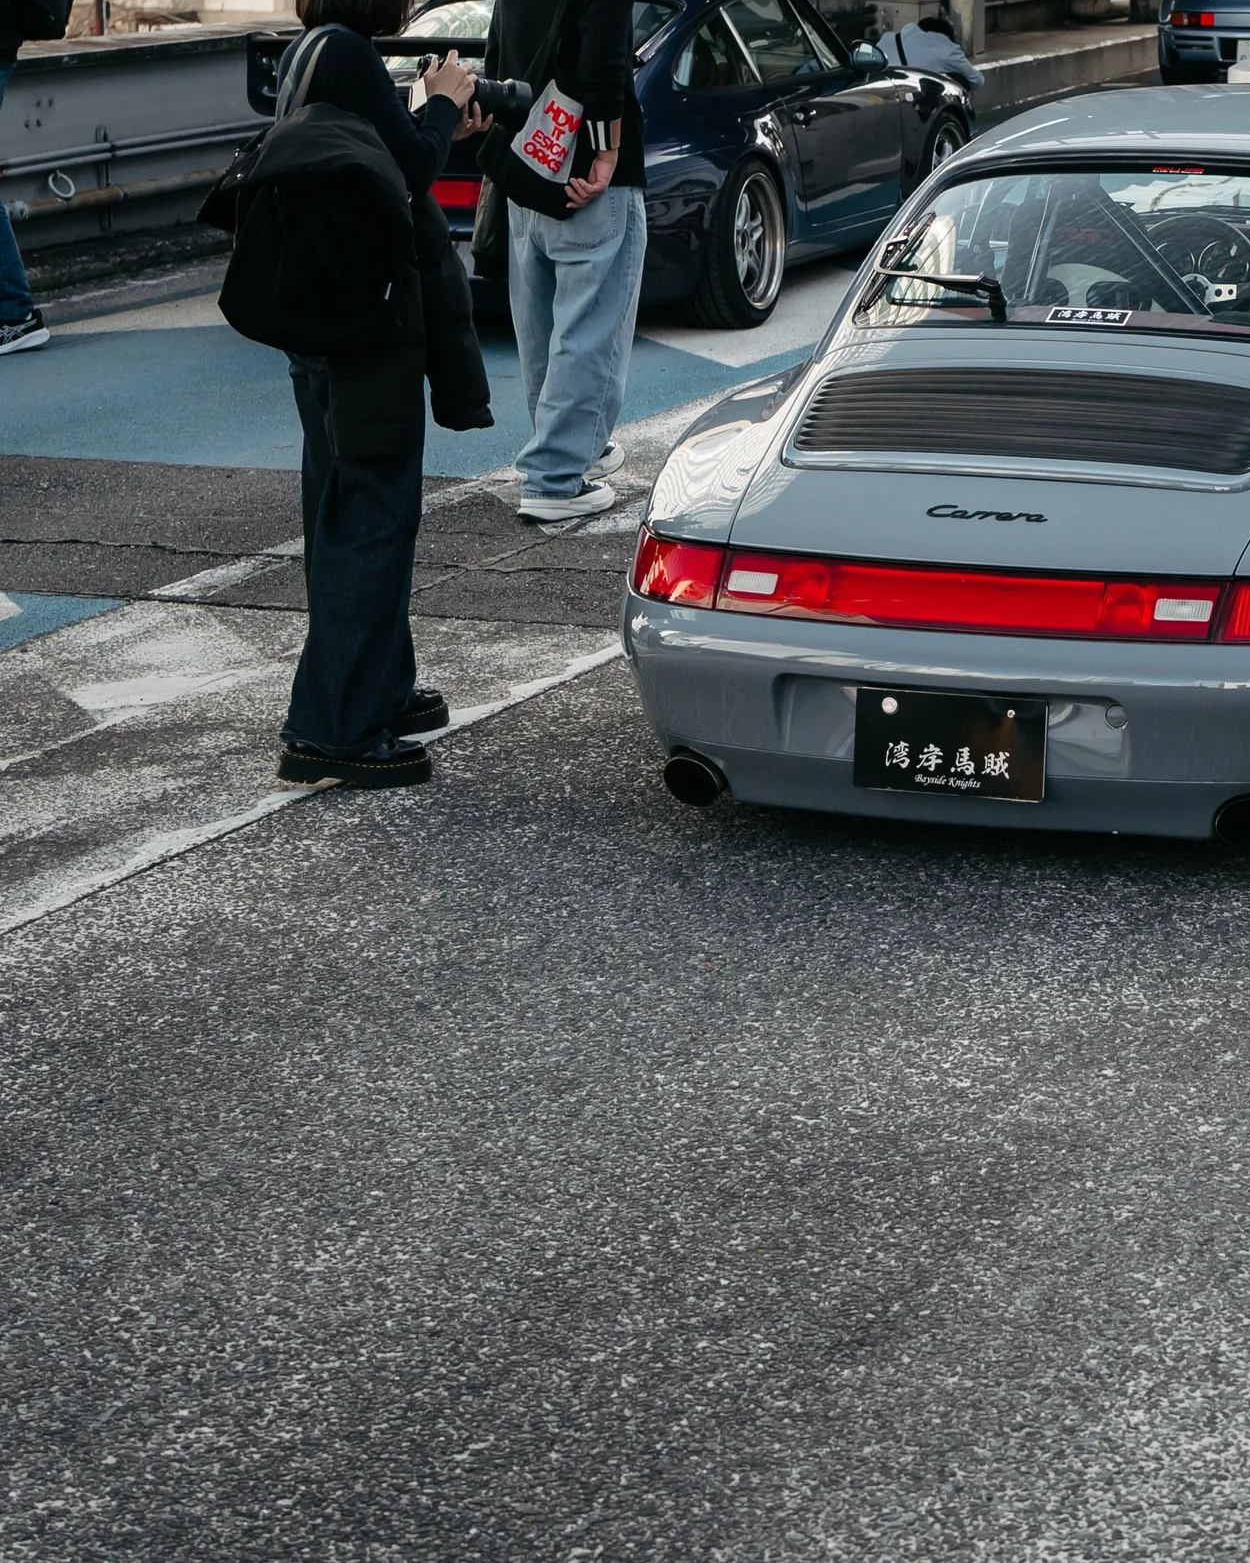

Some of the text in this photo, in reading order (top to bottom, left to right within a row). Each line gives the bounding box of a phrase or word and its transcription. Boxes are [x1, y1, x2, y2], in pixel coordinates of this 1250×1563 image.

[926, 504, 1048, 523] Carrera
[885, 741, 1010, 779] 湾岸馬賊
[914, 773, 982, 789] Bayside Knights
